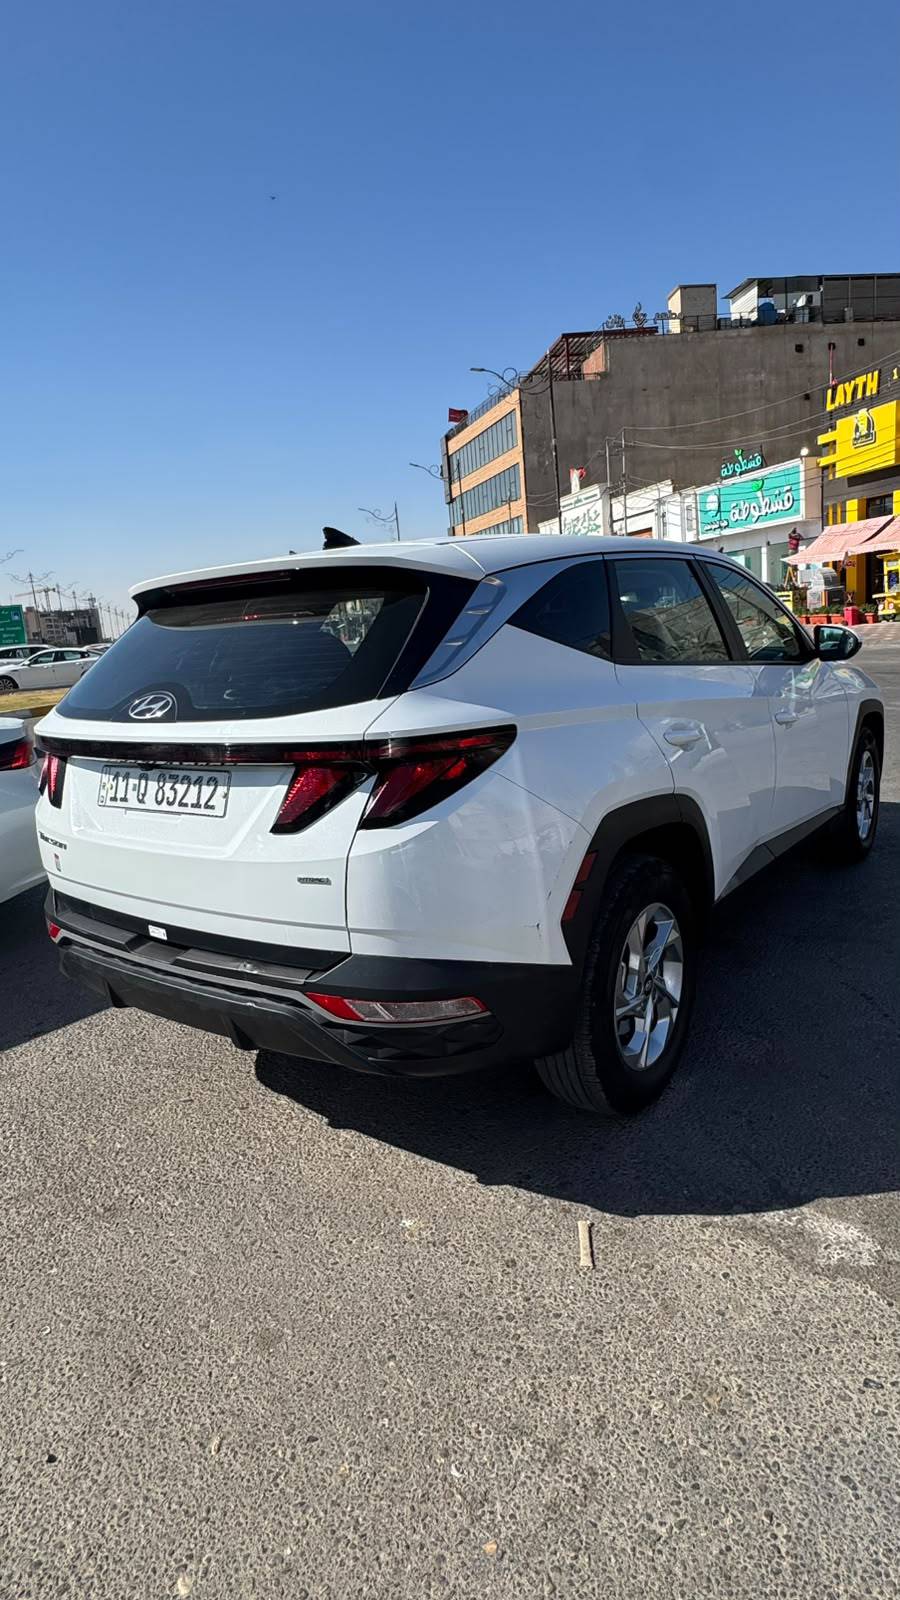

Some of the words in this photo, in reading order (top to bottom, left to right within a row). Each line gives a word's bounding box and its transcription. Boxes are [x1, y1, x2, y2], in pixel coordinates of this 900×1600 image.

[826, 370, 879, 410] LAYTH
[730, 484, 795, 523] قشطوطة
[109, 771, 129, 803] 11
[137, 772, 149, 804] Q
[155, 773, 219, 810] 83212
